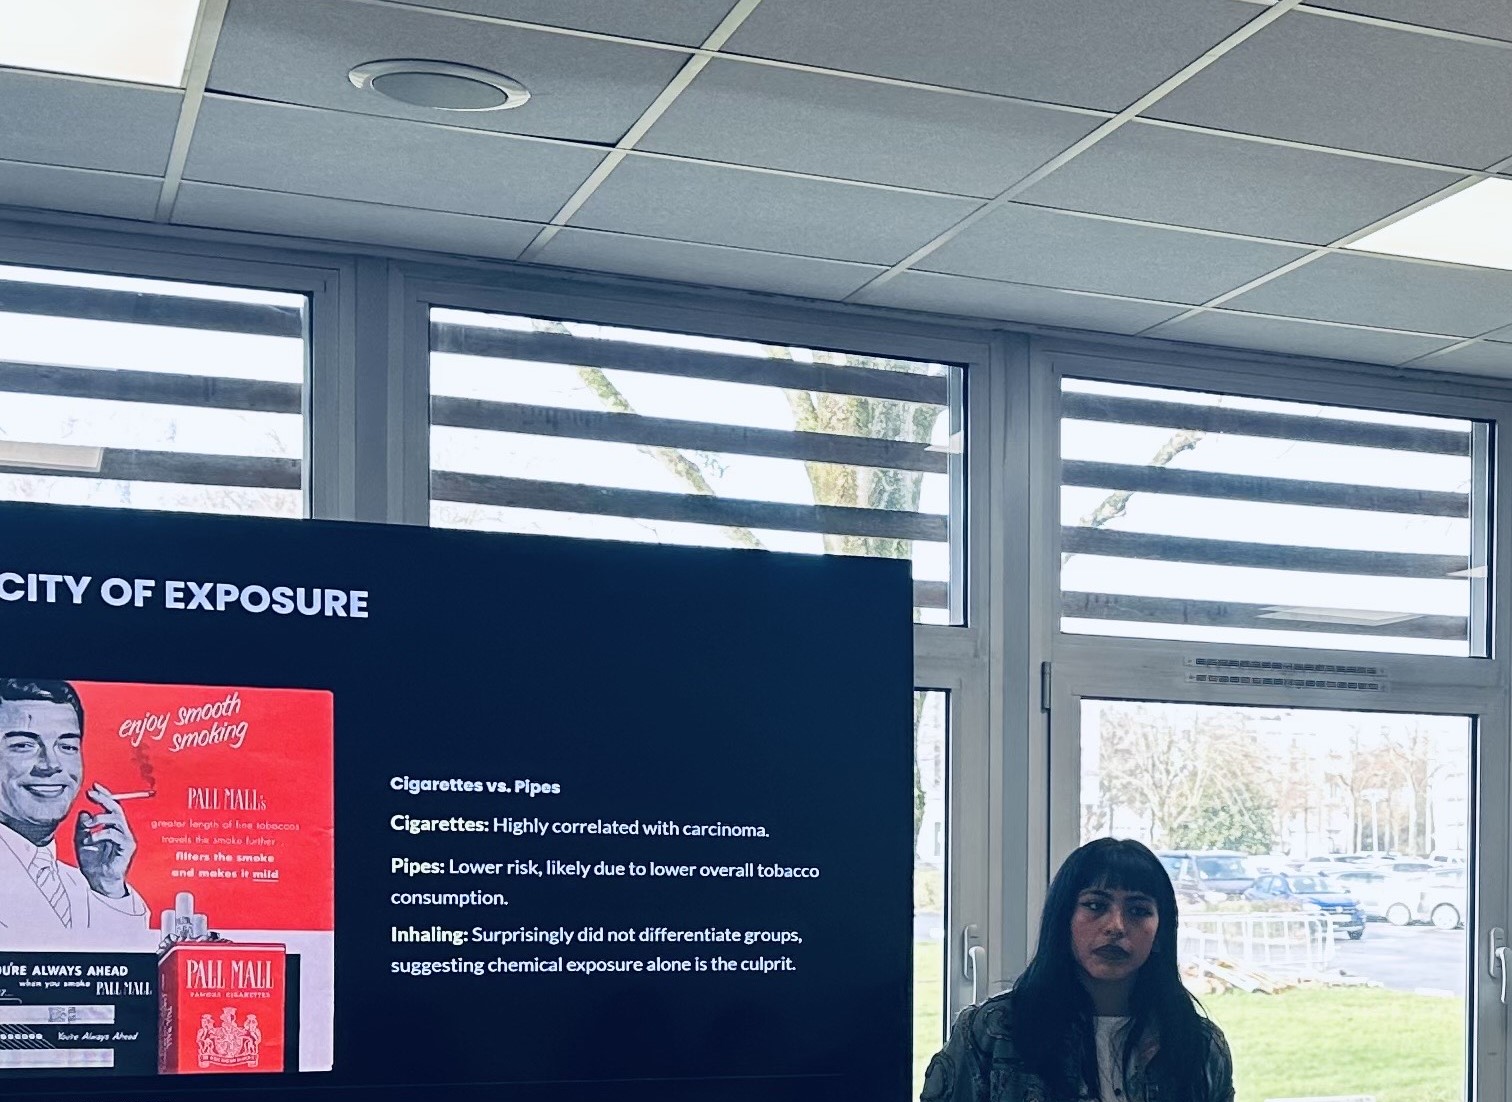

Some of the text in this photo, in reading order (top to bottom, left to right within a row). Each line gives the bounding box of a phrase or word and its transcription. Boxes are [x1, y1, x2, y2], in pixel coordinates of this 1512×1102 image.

[101, 578, 155, 607] OF
[166, 581, 368, 618] EXPOSURE
[119, 692, 241, 746] enjoy smooth
[169, 722, 248, 752] smoking
[390, 776, 560, 797] Cigarettes vs. Pipes
[188, 788, 219, 809] PALL
[190, 819, 219, 831] length
[222, 821, 232, 830] of
[391, 815, 769, 837] Cigarettes: Highly correlated with carcinoma.
[214, 837, 242, 845] smoke
[176, 852, 274, 862] filters the smoke
[172, 869, 279, 878] and makes it mild
[392, 858, 819, 878] Pipes: Lower risk, likely due to lower overall tobacco
[391, 890, 508, 907] consumption.
[392, 926, 802, 945] Inhaling: Surprisingly did not differentiate groups,
[0, 962, 128, 976] U'RE ALWAYS AHEAD
[186, 959, 274, 989] PALL MALL
[391, 956, 796, 975] suggesting chemical exposure alone is the culprit.
[96, 982, 121, 995] PALL
[112, 1032, 139, 1040] Ahead
